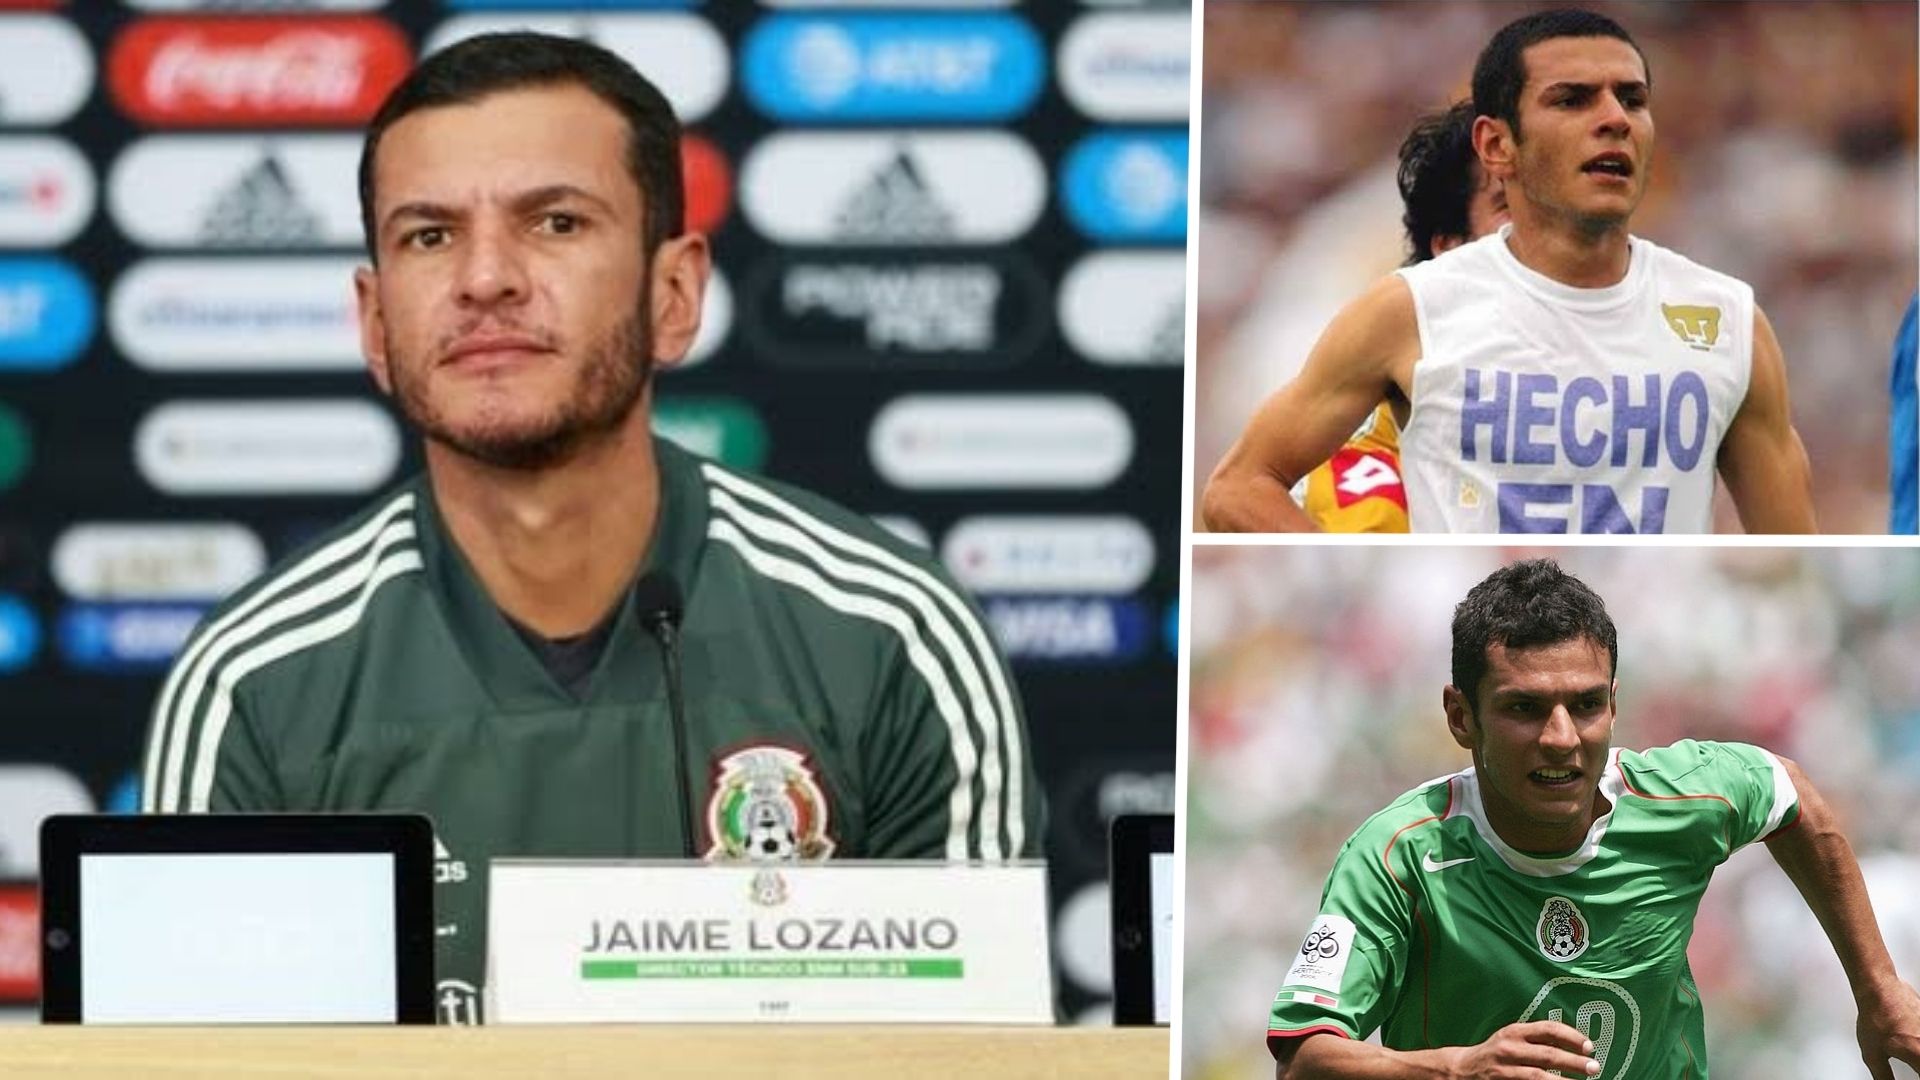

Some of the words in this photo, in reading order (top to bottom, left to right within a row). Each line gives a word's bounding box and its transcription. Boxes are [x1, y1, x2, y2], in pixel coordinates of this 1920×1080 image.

[1461, 368, 1709, 473] HECHO
[1497, 482, 1669, 534] EN
[584, 919, 731, 952] JAIME
[748, 918, 959, 951] LOZANO
